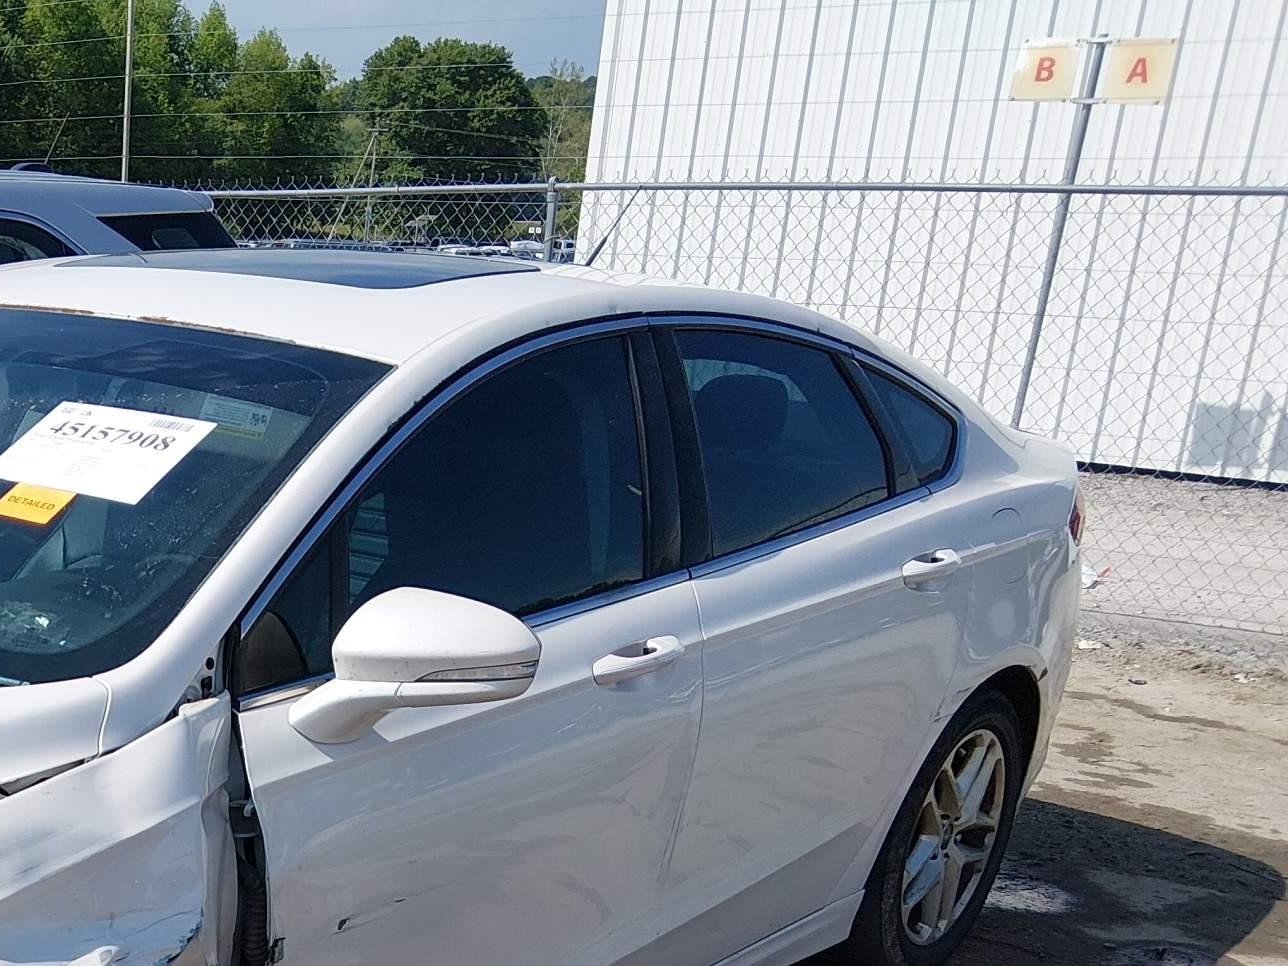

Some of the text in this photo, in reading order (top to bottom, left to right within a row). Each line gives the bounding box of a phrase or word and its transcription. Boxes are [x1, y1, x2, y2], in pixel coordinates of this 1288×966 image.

[1034, 56, 1056, 82] B
[1125, 57, 1148, 84] A
[49, 419, 177, 453] 45157908
[6, 494, 56, 512] DETAILED
